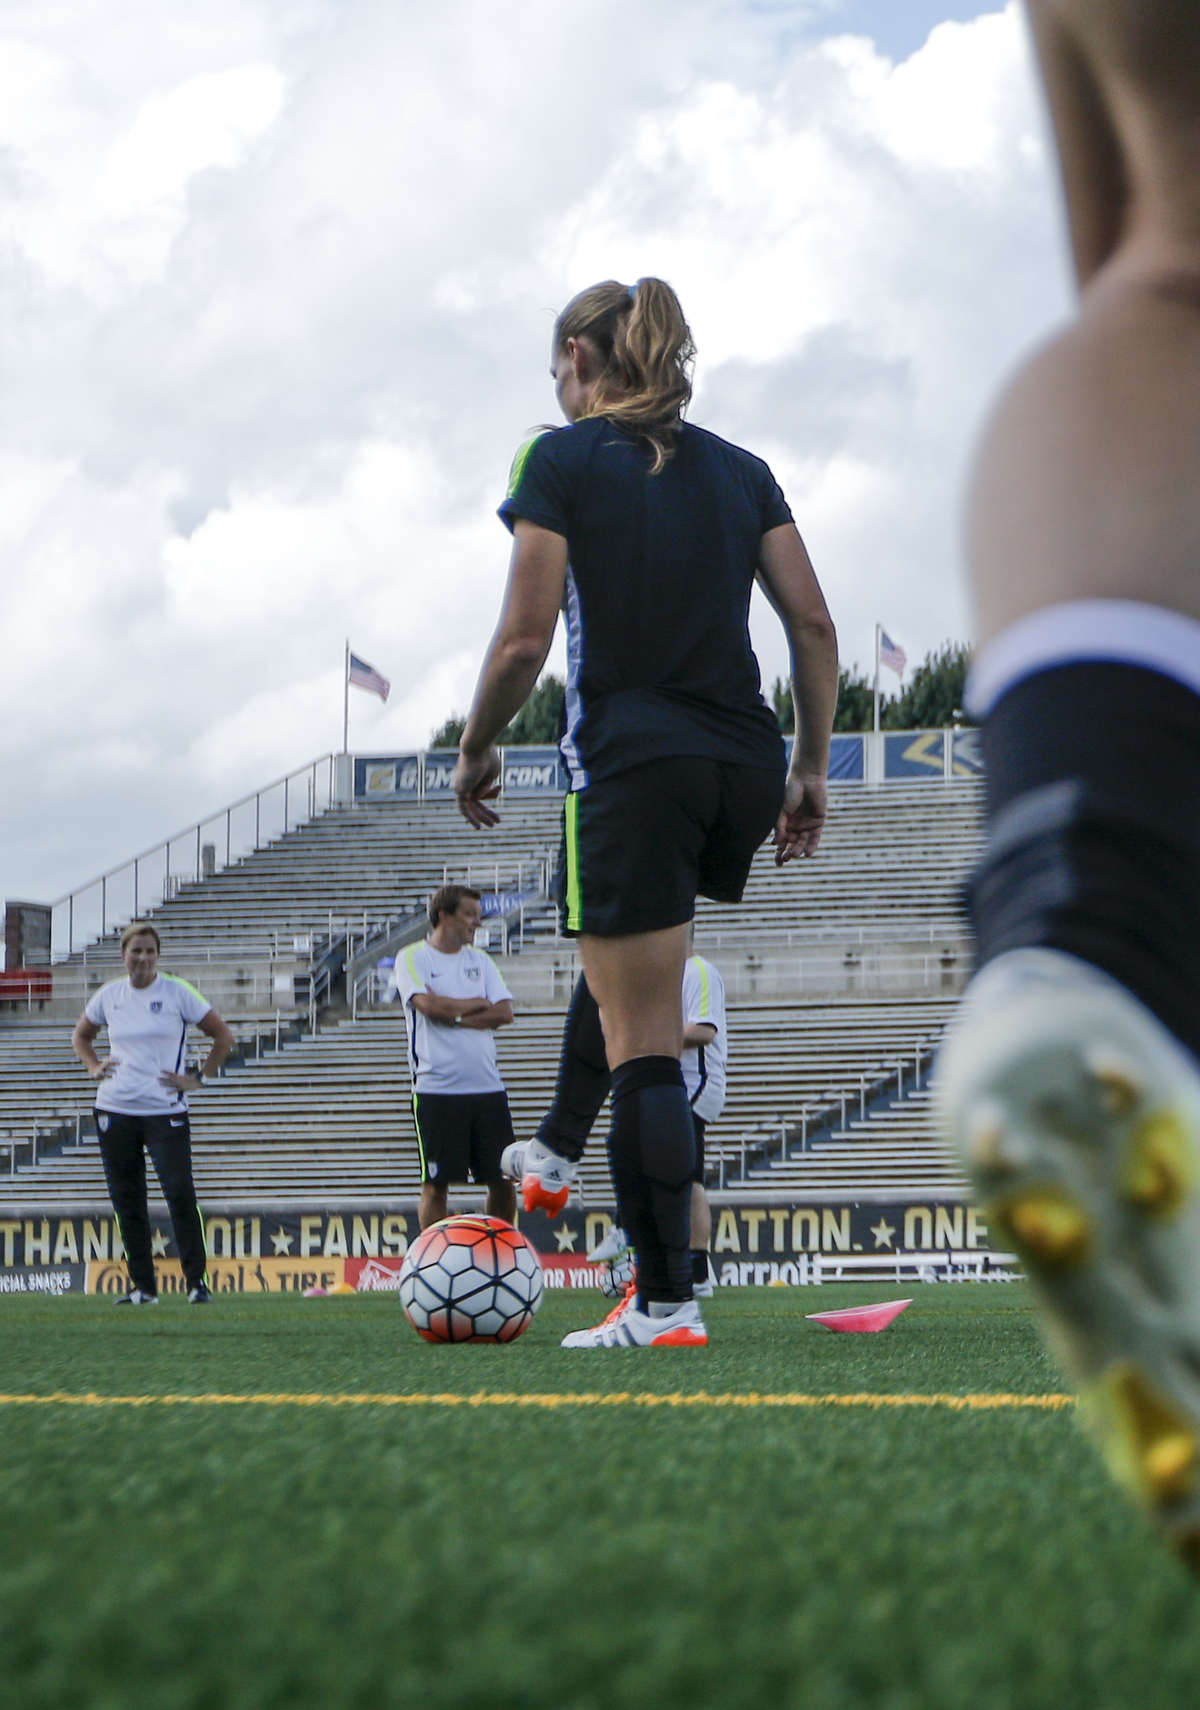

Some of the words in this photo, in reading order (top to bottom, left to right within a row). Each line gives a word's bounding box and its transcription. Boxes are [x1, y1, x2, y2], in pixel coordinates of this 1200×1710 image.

[205, 1216, 260, 1260] OU
[301, 1214, 408, 1258] FANS
[904, 1206, 989, 1250] ONE
[28, 1271, 71, 1291] SNACKS
[544, 1268, 566, 1289] OR
